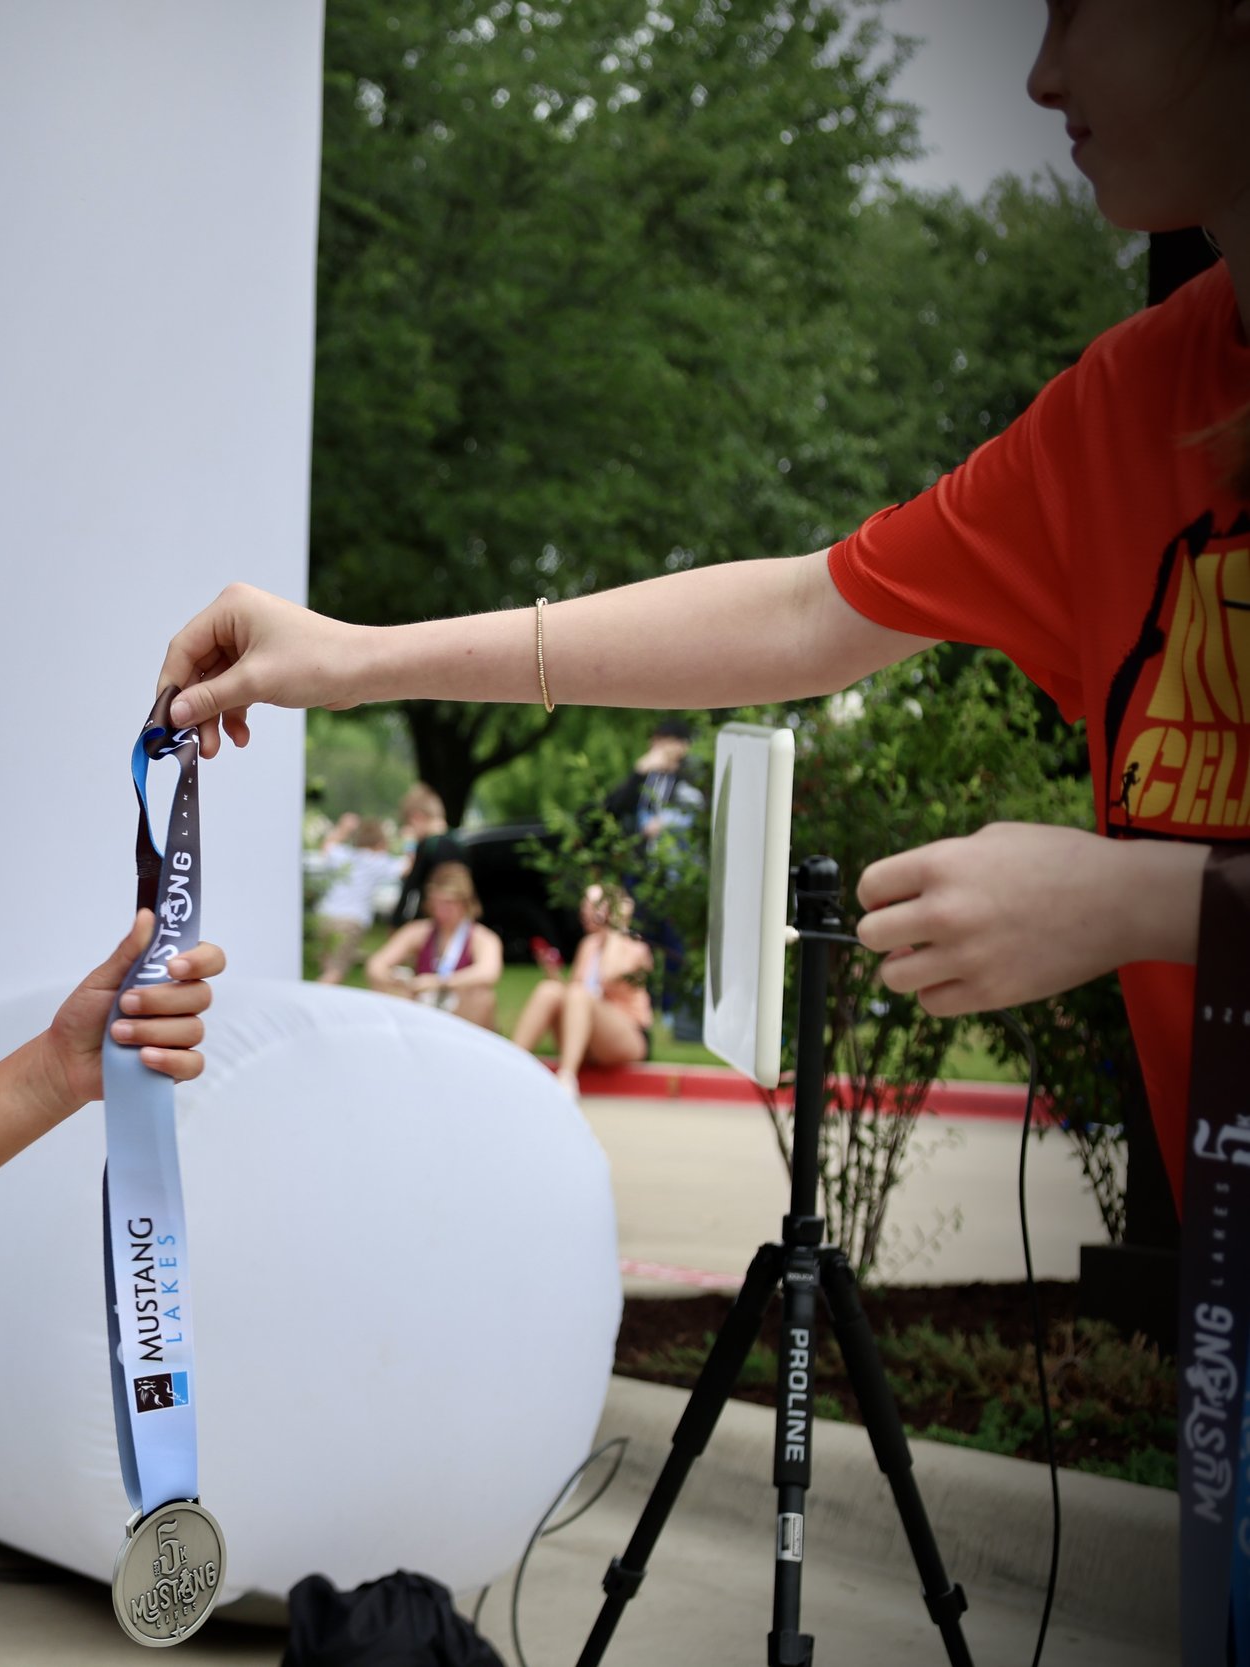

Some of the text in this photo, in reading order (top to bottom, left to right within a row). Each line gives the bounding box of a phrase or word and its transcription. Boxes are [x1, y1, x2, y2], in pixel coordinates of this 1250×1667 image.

[134, 851, 193, 985] USTANG
[127, 1217, 163, 1362] MUSTANG
[157, 1234, 183, 1343] LAKES
[784, 1327, 810, 1463] PROLINE
[131, 1562, 218, 1625] MUSTANG
[155, 1602, 197, 1629] LAKES
